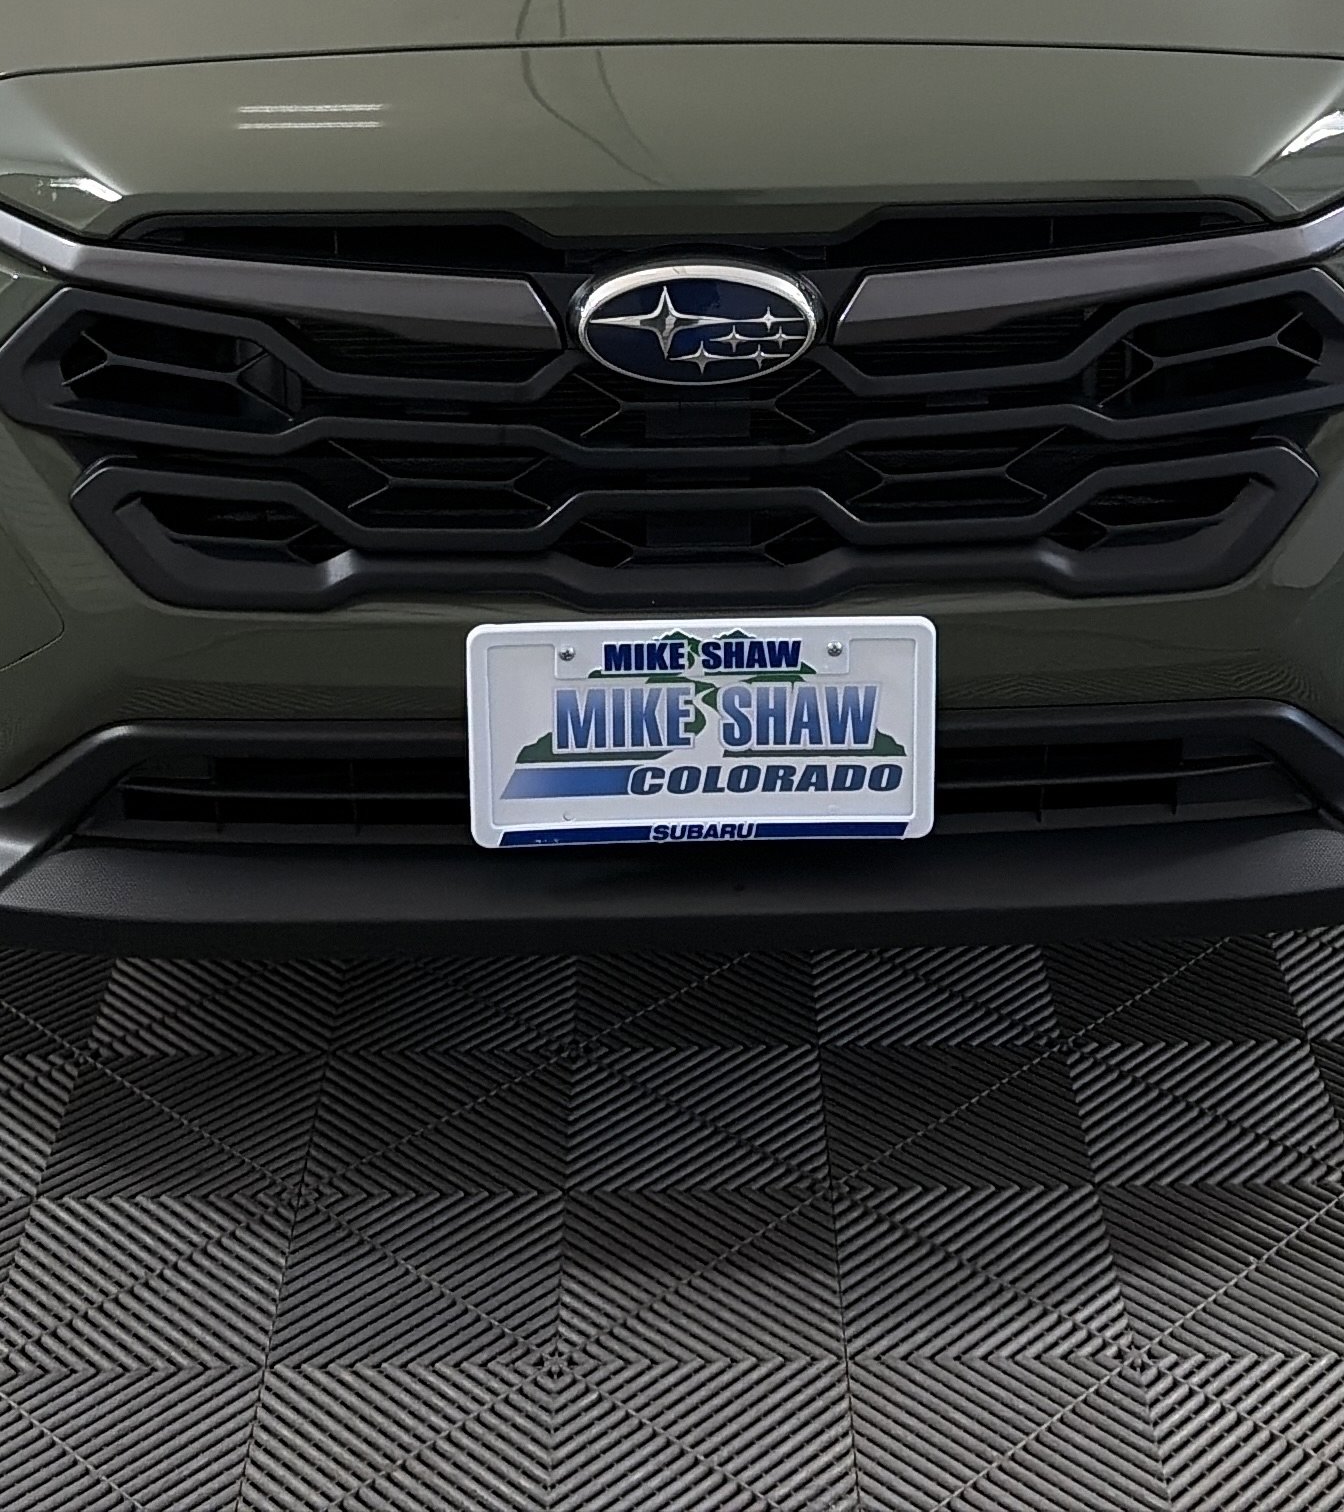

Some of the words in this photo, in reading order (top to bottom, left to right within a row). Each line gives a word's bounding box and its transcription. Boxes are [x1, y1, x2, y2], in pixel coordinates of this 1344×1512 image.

[603, 642, 685, 672] MIKE
[701, 640, 802, 670] SHAW
[557, 687, 692, 750] MIKE
[722, 685, 878, 747] SHAW
[629, 764, 903, 795] COLORADO
[652, 822, 754, 841] SUBARU
